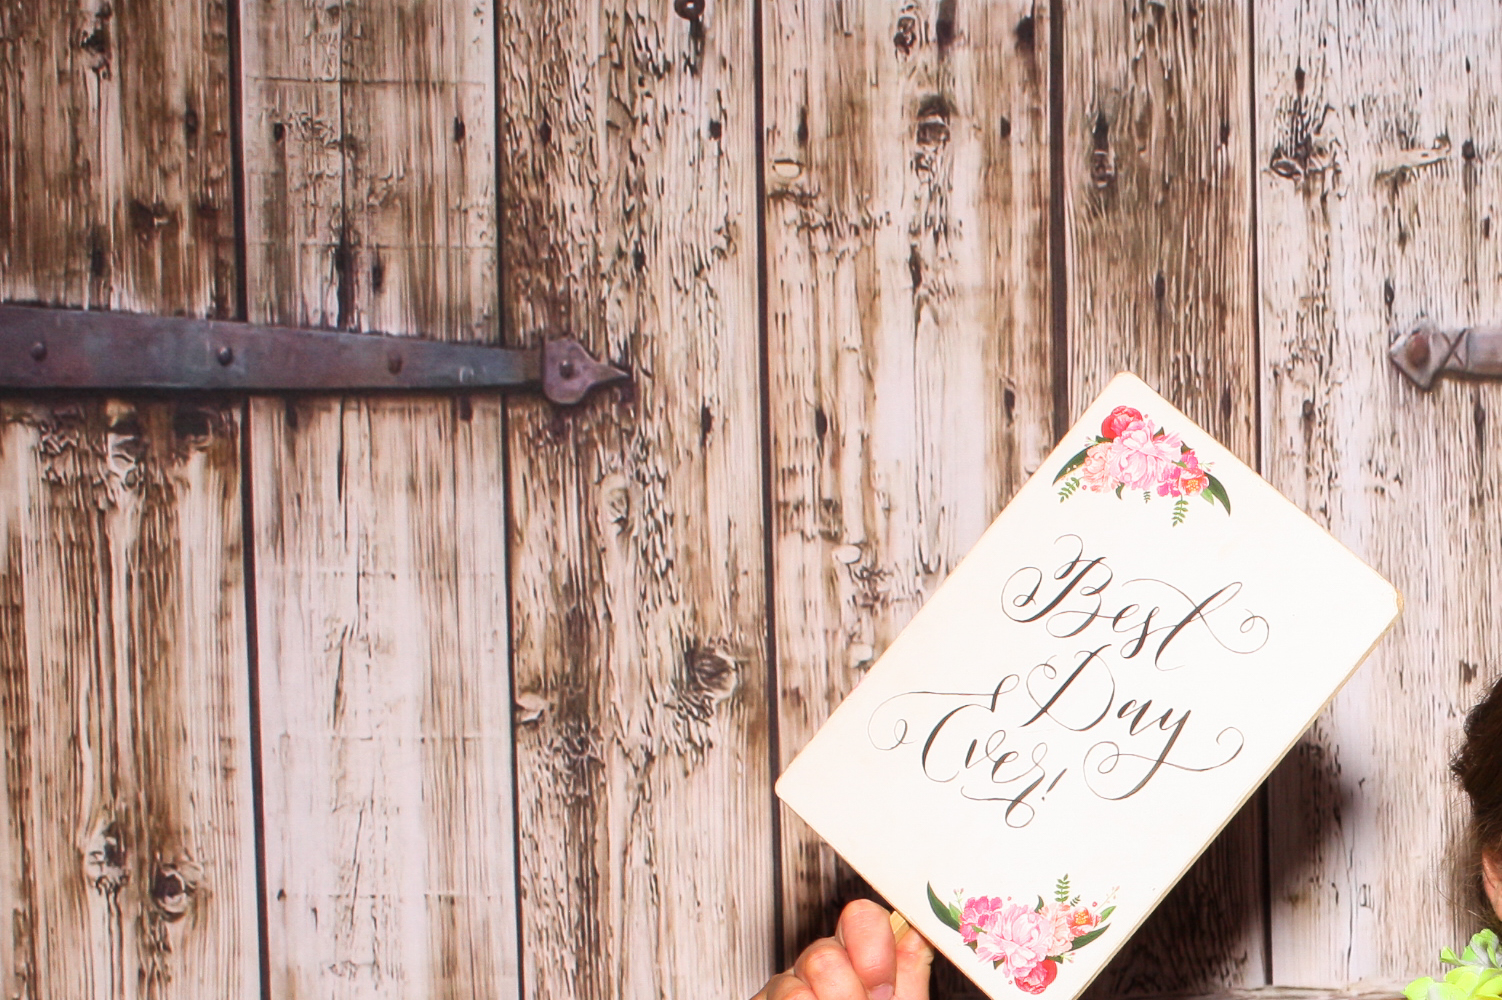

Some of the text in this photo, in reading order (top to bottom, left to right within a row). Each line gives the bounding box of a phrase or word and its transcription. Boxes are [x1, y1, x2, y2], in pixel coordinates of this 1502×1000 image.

[1001, 533, 1270, 671] Best
[867, 674, 1068, 829] Ever!
[1026, 644, 1245, 800] Day
